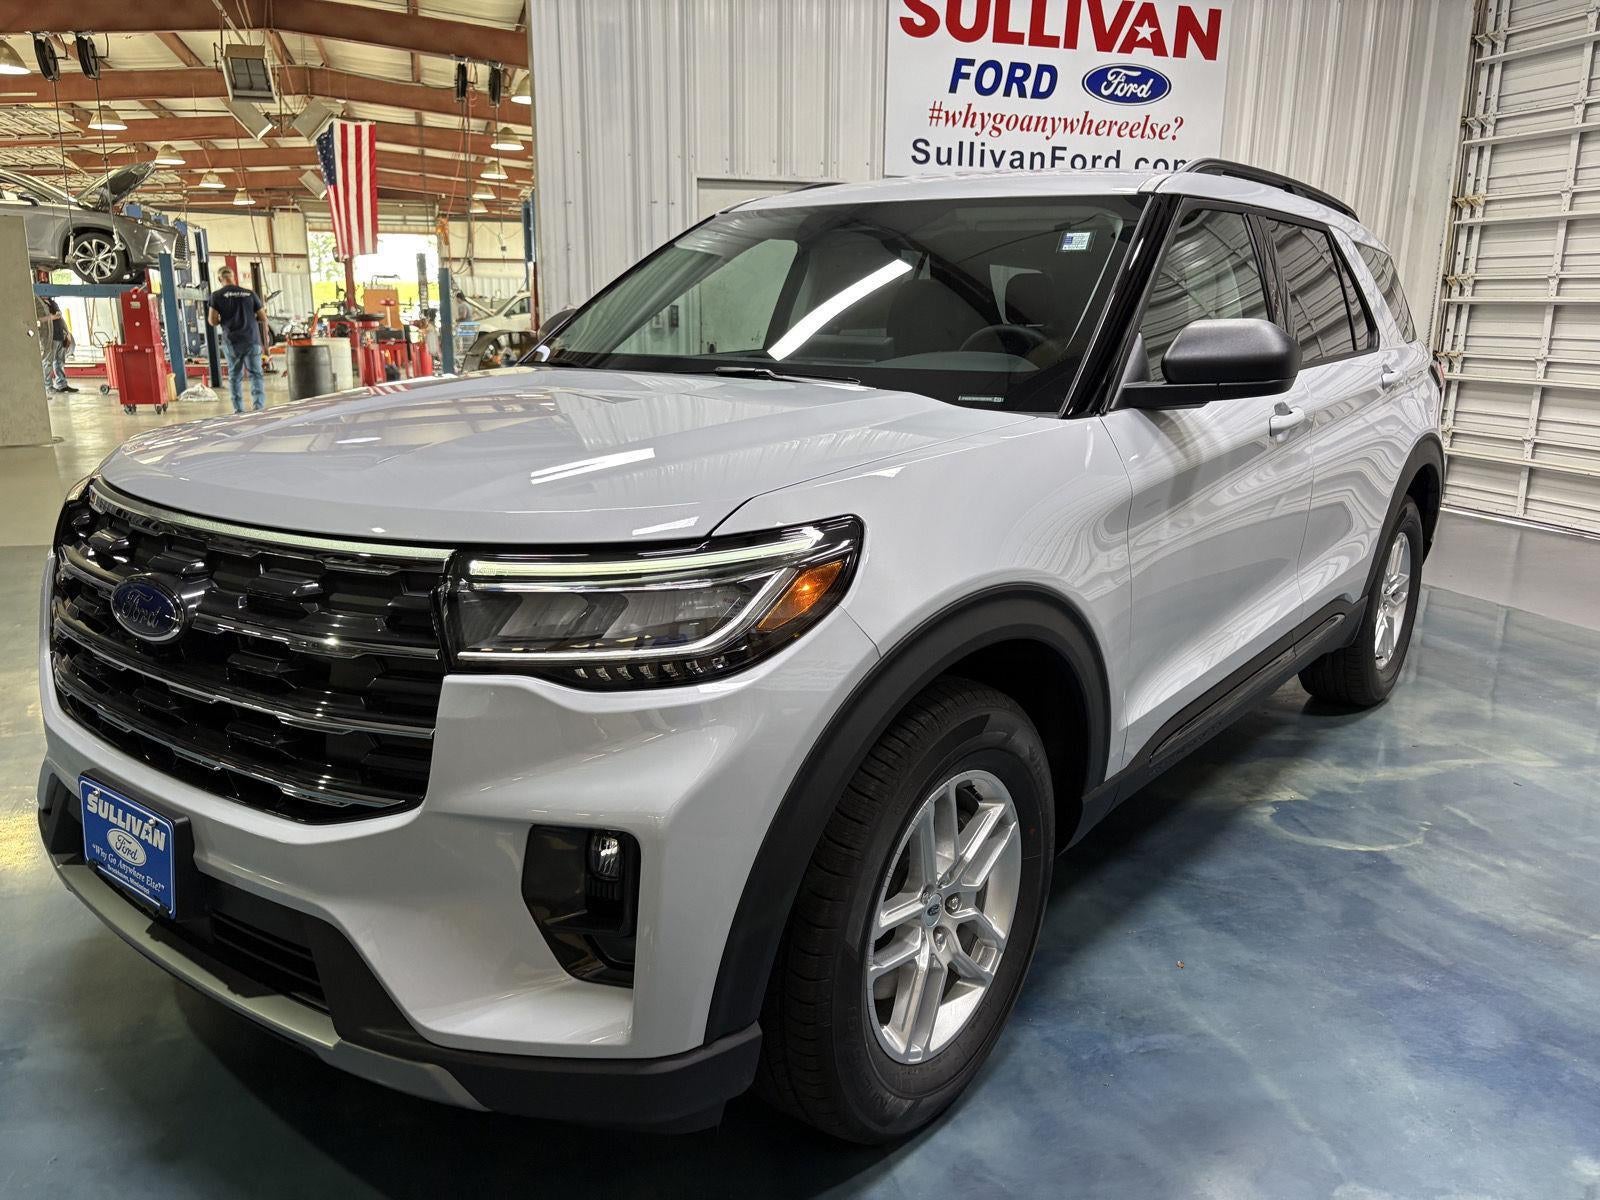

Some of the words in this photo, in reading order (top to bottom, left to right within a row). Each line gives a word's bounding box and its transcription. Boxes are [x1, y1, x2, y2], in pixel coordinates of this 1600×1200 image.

[899, 0, 1222, 61] SULLIVAN
[949, 57, 1058, 100] FORD
[1100, 67, 1154, 99] Ford
[928, 101, 1184, 142] #whygoanywhereelse?
[911, 138, 1191, 172] SullivanFordco
[87, 793, 166, 852] SULLIVAN
[115, 834, 138, 861] Ford
